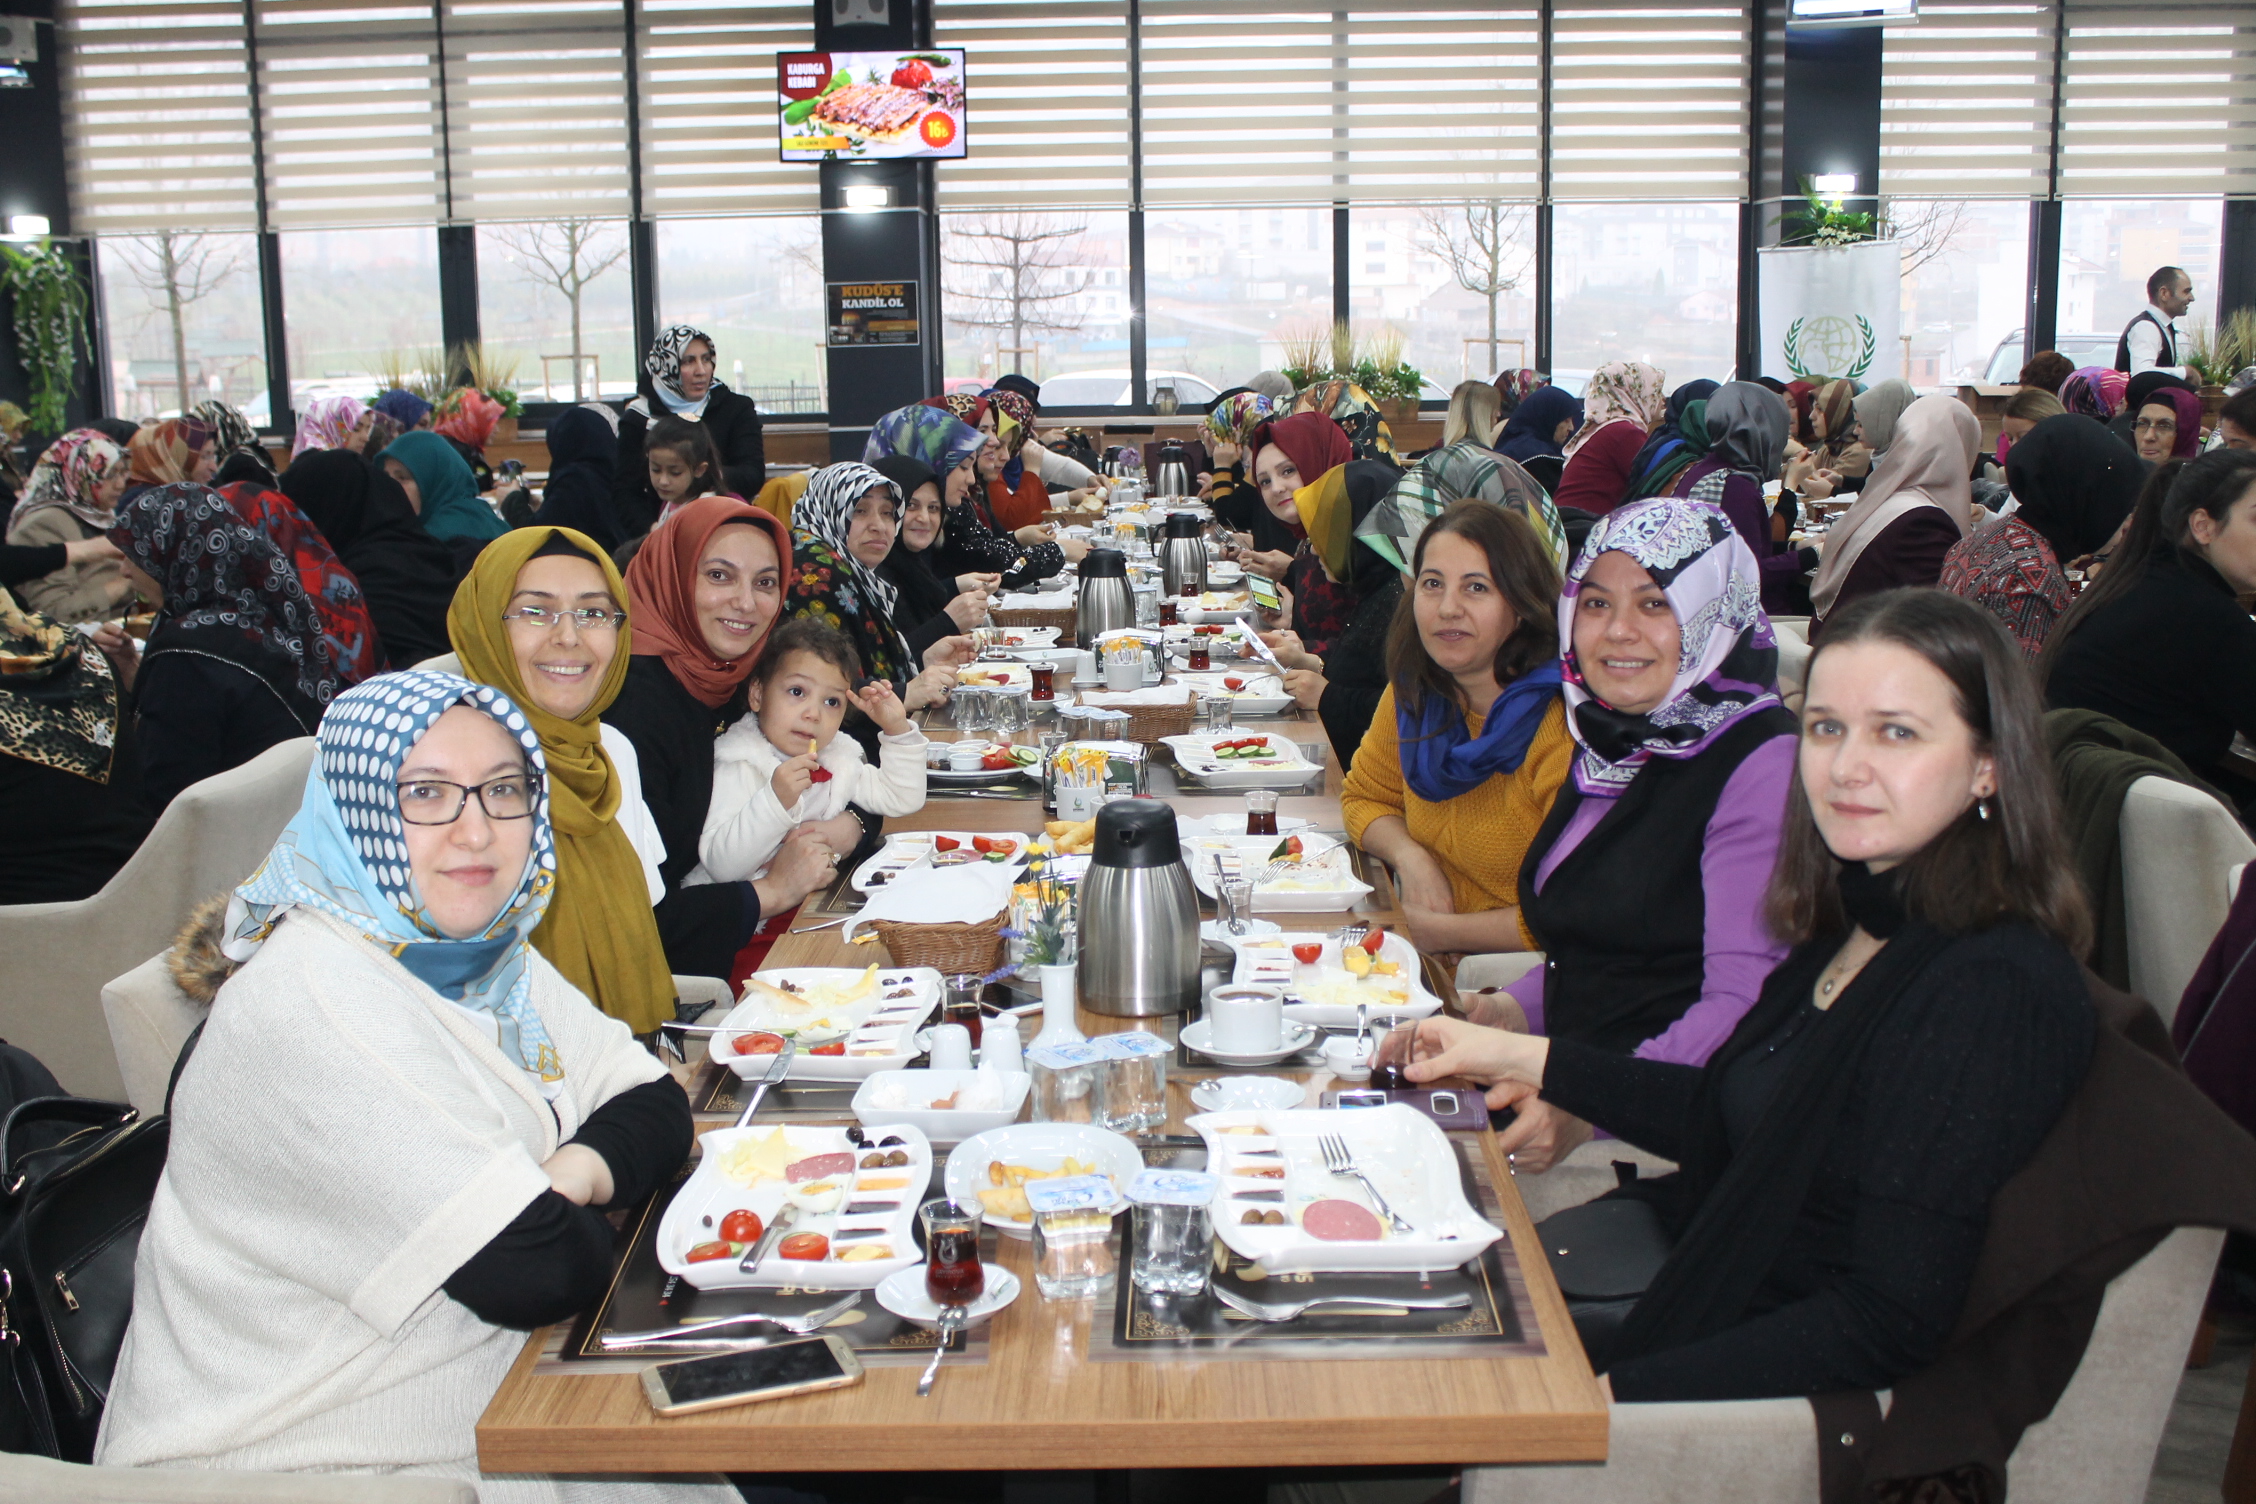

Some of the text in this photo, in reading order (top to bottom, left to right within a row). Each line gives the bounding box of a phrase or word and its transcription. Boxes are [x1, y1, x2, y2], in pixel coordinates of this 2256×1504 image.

[787, 63, 825, 75] KABURGA
[787, 76, 816, 89] KEBABI
[842, 297, 904, 309] KANDİL OL
